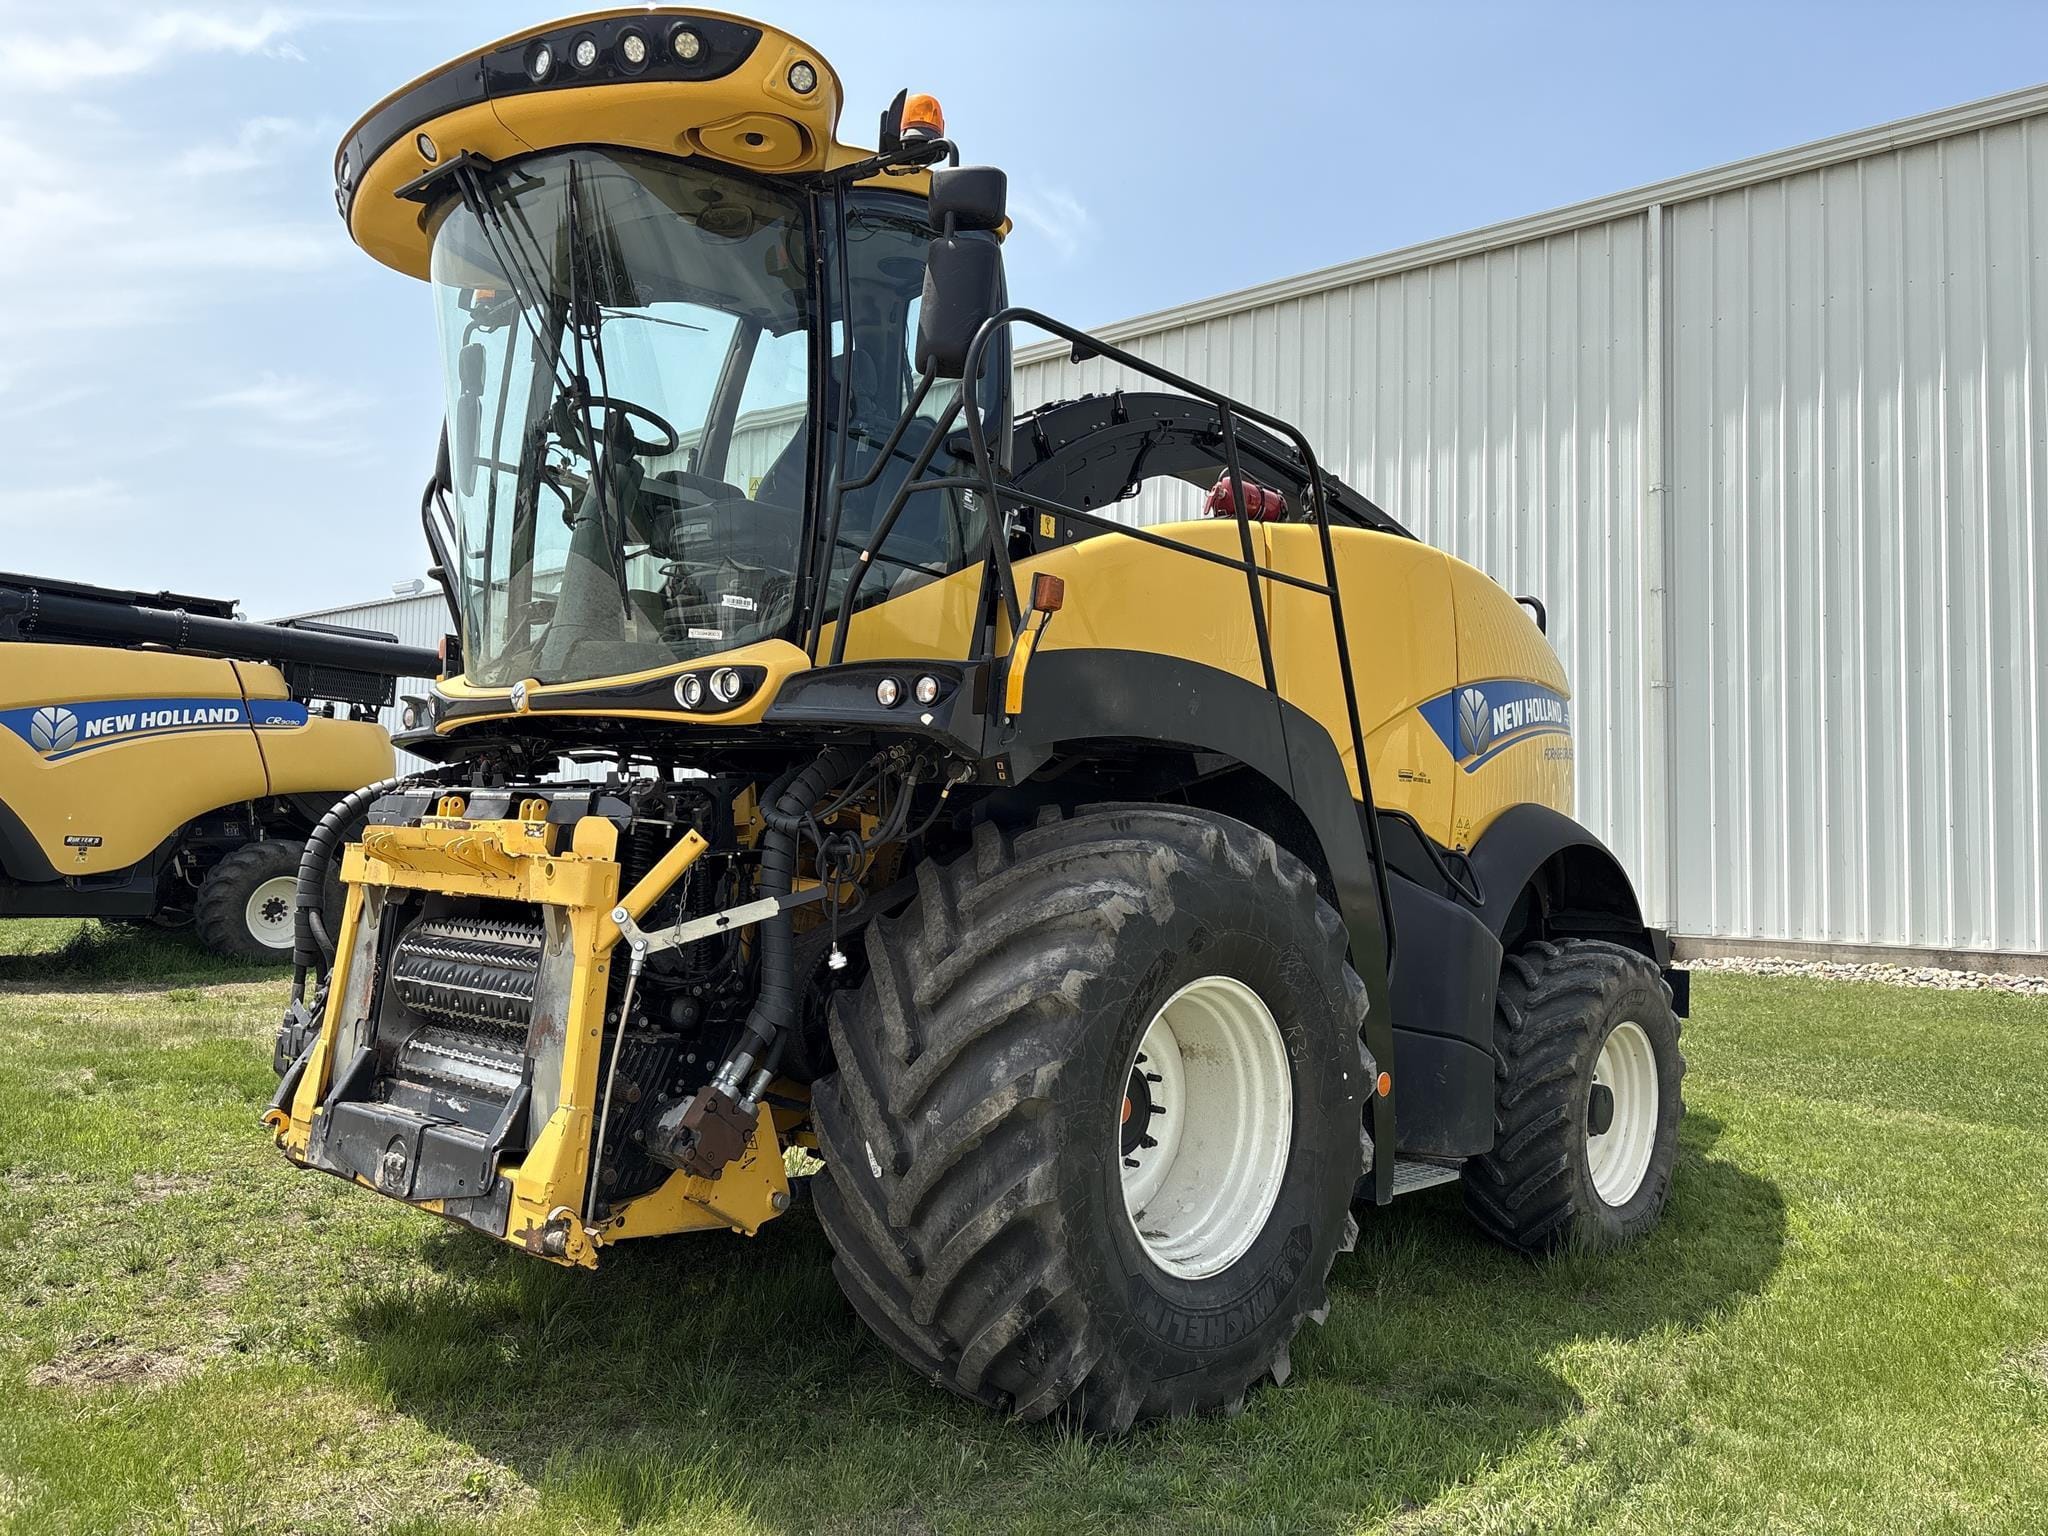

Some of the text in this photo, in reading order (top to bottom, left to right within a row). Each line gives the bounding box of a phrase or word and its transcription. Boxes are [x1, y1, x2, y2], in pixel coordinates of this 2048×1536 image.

[85, 708, 240, 738] NEW HOLLAND
[1493, 697, 1562, 736] NEW HOLLAND
[1135, 1278, 1279, 1346] MICHELIN
